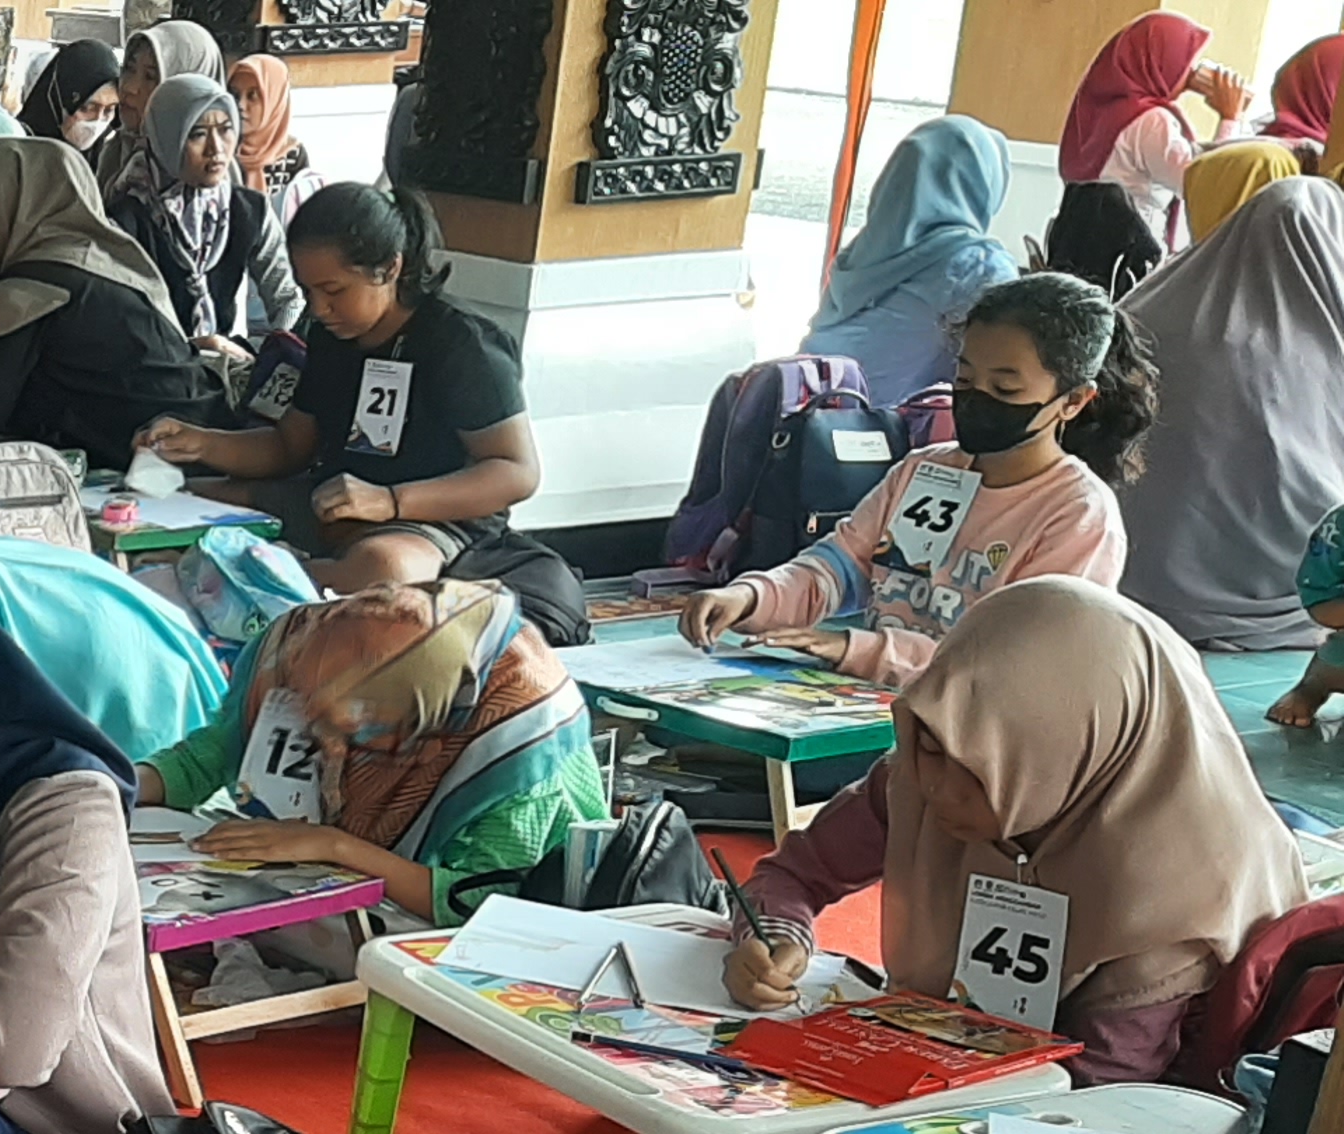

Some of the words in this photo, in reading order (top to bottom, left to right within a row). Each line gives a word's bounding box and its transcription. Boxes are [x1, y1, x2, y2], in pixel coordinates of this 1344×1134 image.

[366, 386, 398, 417] 21
[902, 495, 961, 533] 43
[880, 572, 963, 620] FOR
[266, 727, 321, 781] 12
[970, 926, 1051, 984] 45
